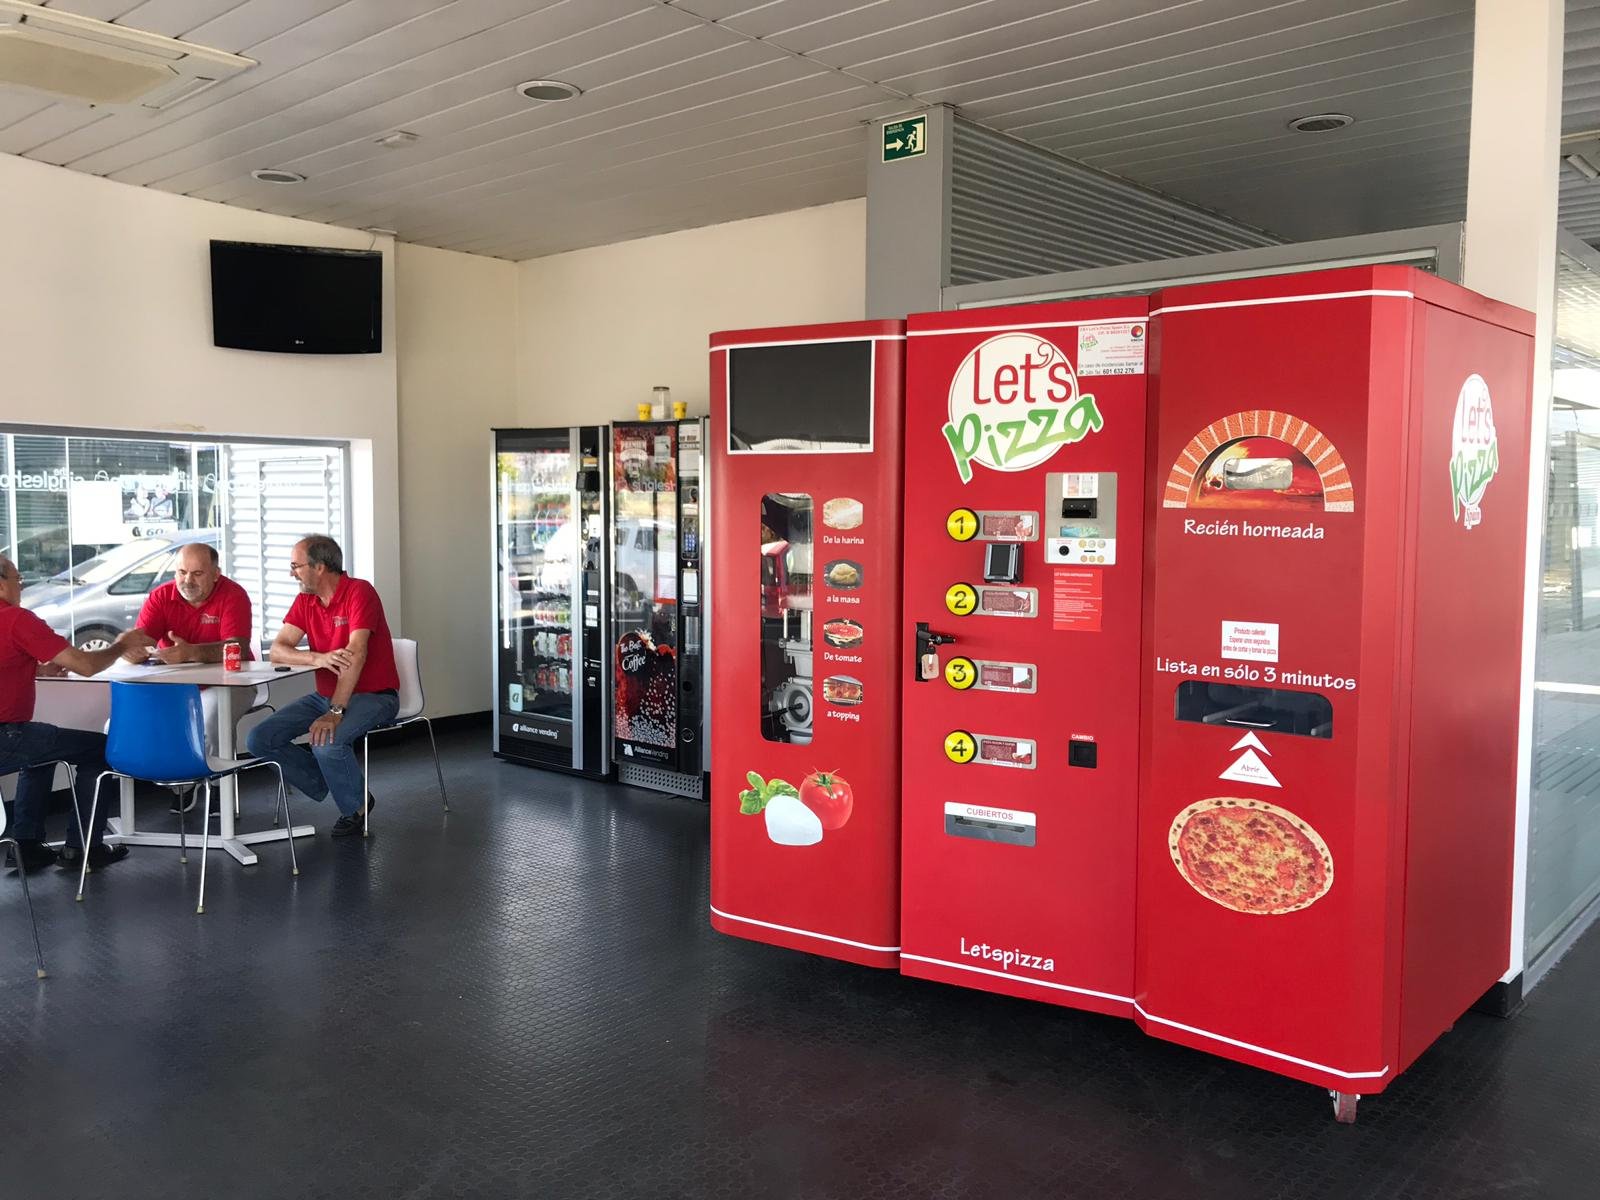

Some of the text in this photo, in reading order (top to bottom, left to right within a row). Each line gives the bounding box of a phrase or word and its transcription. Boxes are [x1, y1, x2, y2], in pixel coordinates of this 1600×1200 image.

[973, 342, 1072, 405] Let's
[1461, 388, 1492, 445] Let's
[955, 516, 965, 535] 1
[1184, 519, 1325, 539] Recién horneada
[823, 535, 865, 545] De la harina
[832, 595, 839, 603] la
[840, 596, 861, 604] masa
[953, 590, 968, 609] 2
[621, 653, 646, 673] Coffee
[824, 652, 863, 663] De tomate
[952, 664, 967, 683] 3
[1156, 656, 1357, 690] Lista en sólo 3 minutos
[832, 711, 860, 722] topping
[520, 724, 539, 735] alliance
[1071, 733, 1094, 741] CAMBIO
[951, 738, 967, 757] 4
[966, 806, 1014, 821] CUBIERTOS
[960, 936, 1055, 972] Letspizza
